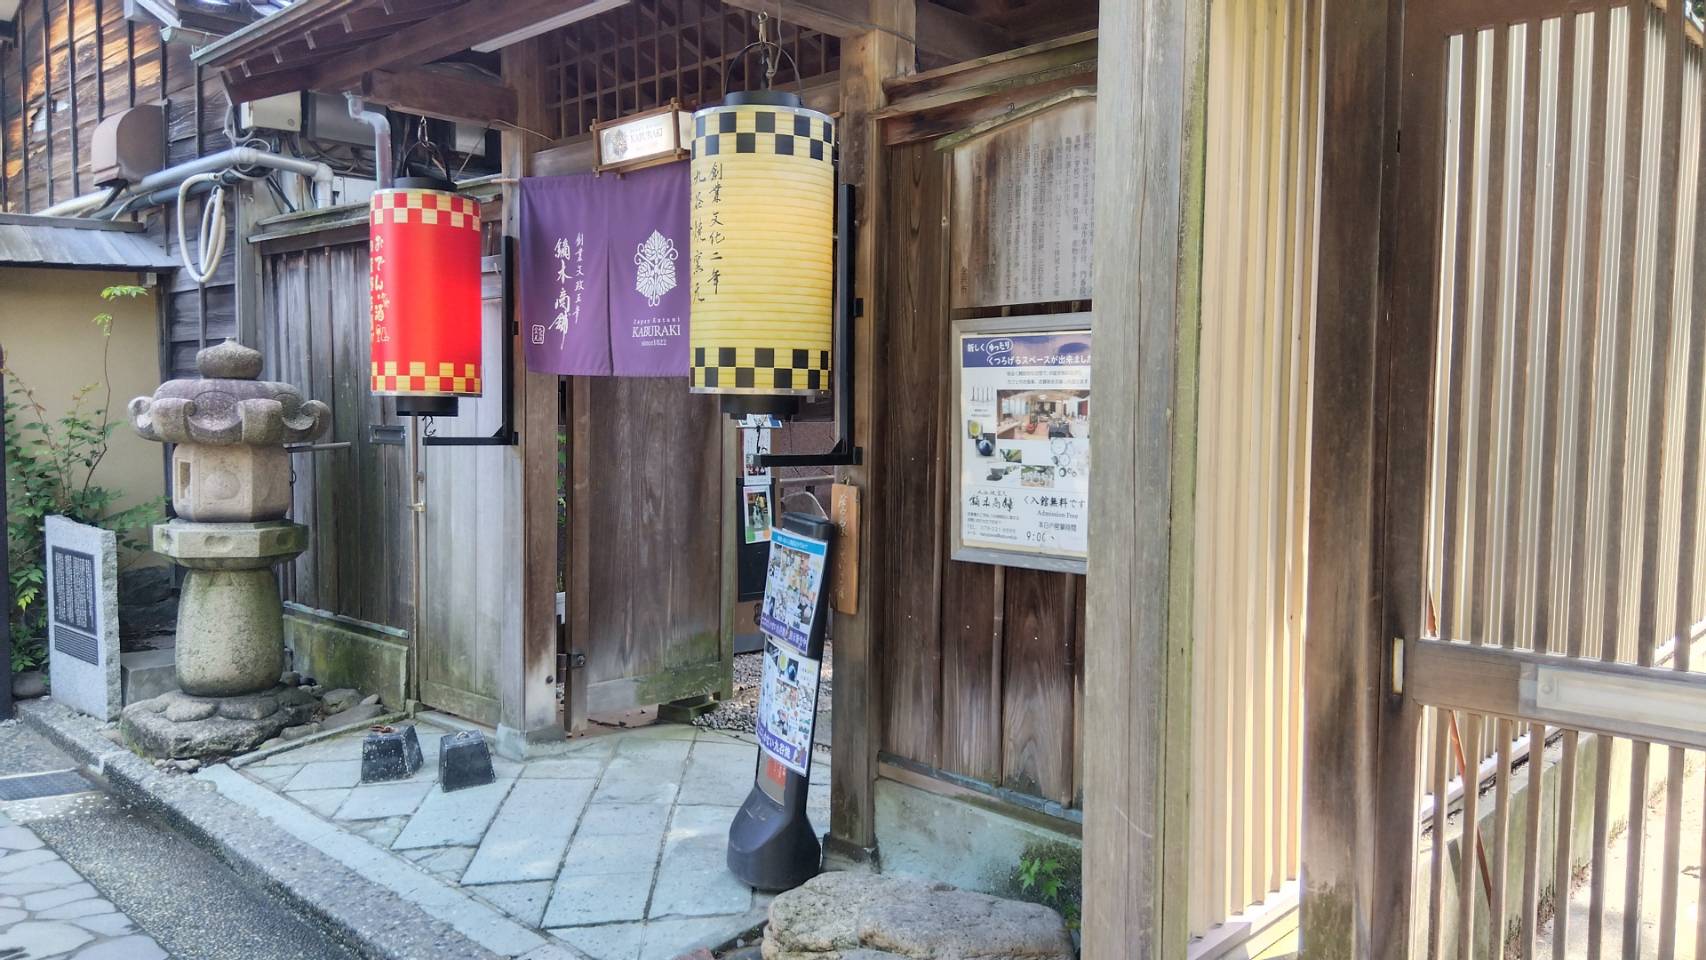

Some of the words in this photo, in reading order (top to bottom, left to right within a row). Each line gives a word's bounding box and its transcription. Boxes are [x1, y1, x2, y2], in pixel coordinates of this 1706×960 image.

[706, 160, 725, 296] 創業文化二年
[631, 324, 682, 338] KABURAKI
[967, 343, 985, 353] 新しく
